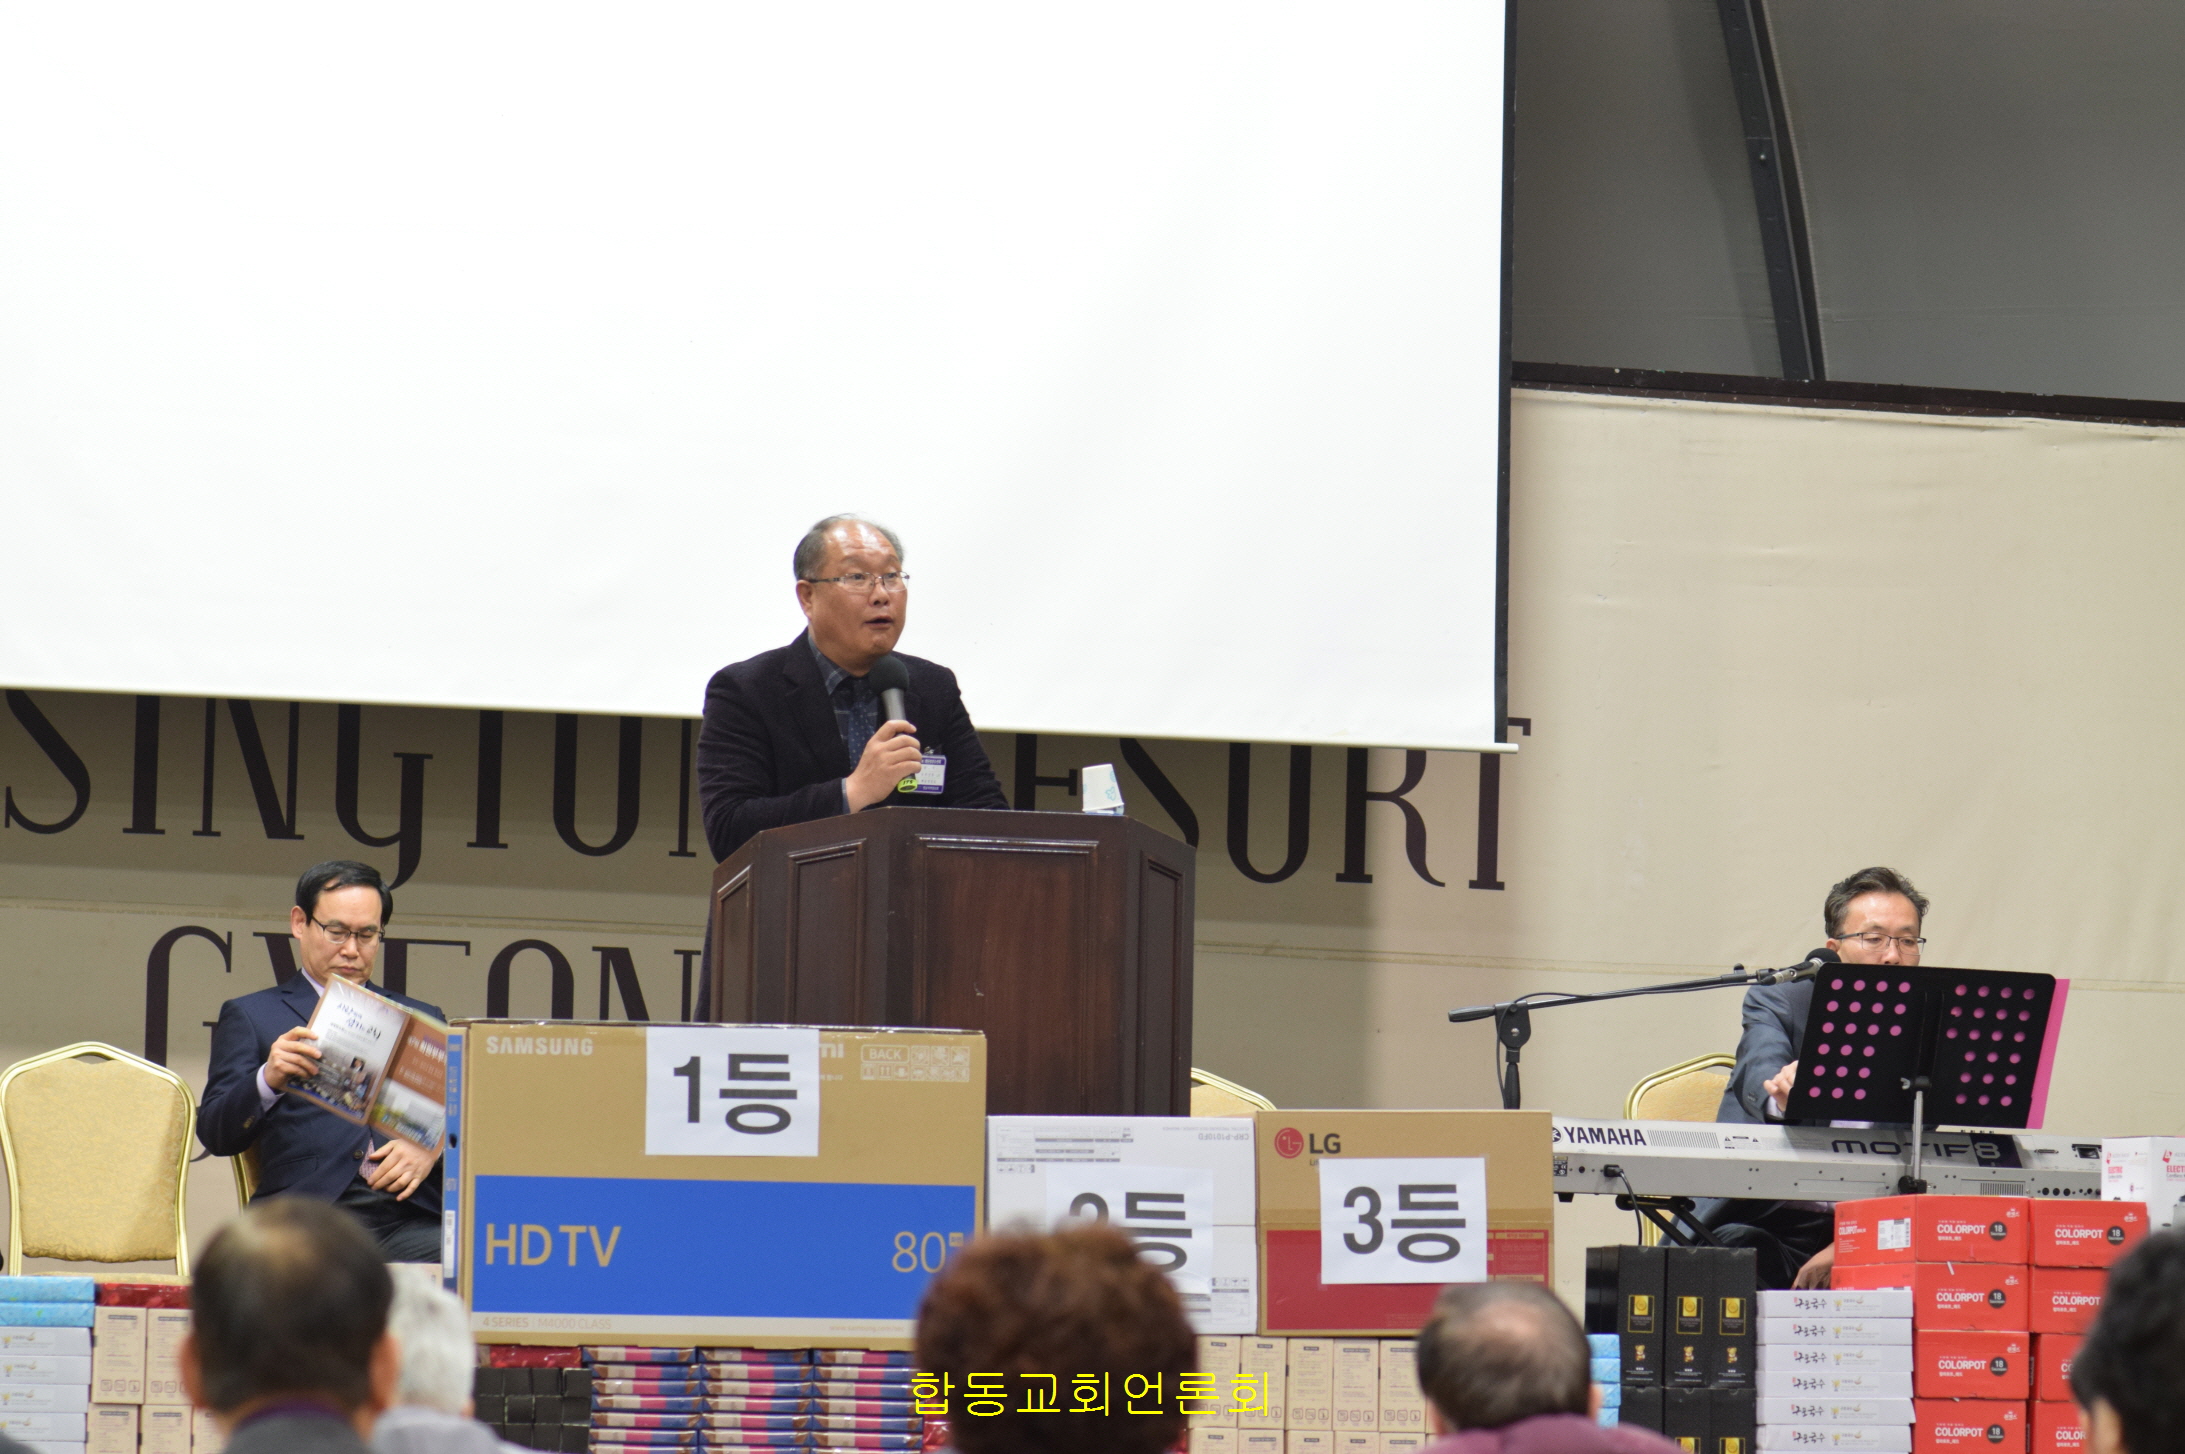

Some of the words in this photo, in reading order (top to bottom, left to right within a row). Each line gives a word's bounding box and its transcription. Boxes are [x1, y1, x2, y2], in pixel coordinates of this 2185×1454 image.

[486, 1035, 594, 1056] SAMSUNG
[869, 1048, 902, 1060] BACK
[673, 1053, 798, 1135] 1등
[1563, 1126, 1647, 1147] YAMAHA
[1309, 1132, 1342, 1155] LG
[1831, 1139, 2002, 1159] MOIF8
[2166, 1165, 2185, 1173] ELECT
[1342, 1183, 1466, 1264] 3등
[1993, 1224, 2003, 1233] 18
[1936, 1224, 1986, 1235] COLORPOT
[2054, 1229, 2104, 1239] COLORPOT
[2111, 1229, 2121, 1237] 18
[485, 1223, 552, 1266] HD
[559, 1225, 622, 1267] TV
[892, 1231, 947, 1273] 80
[1936, 1292, 1985, 1303] COLORPOT
[1993, 1292, 2002, 1301] 18
[2052, 1296, 2101, 1306] COLORPOT
[482, 1317, 490, 1327] 4
[492, 1317, 529, 1328] SERIES
[538, 1319, 576, 1330] M4000
[578, 1320, 612, 1330] CLASS
[1938, 1360, 1987, 1370] COLORPOT
[1994, 1360, 2004, 1368] 18
[1935, 1427, 1984, 1438] COLORPOT
[1992, 1427, 2001, 1436] 18
[2056, 1430, 2087, 1440] COLOR
